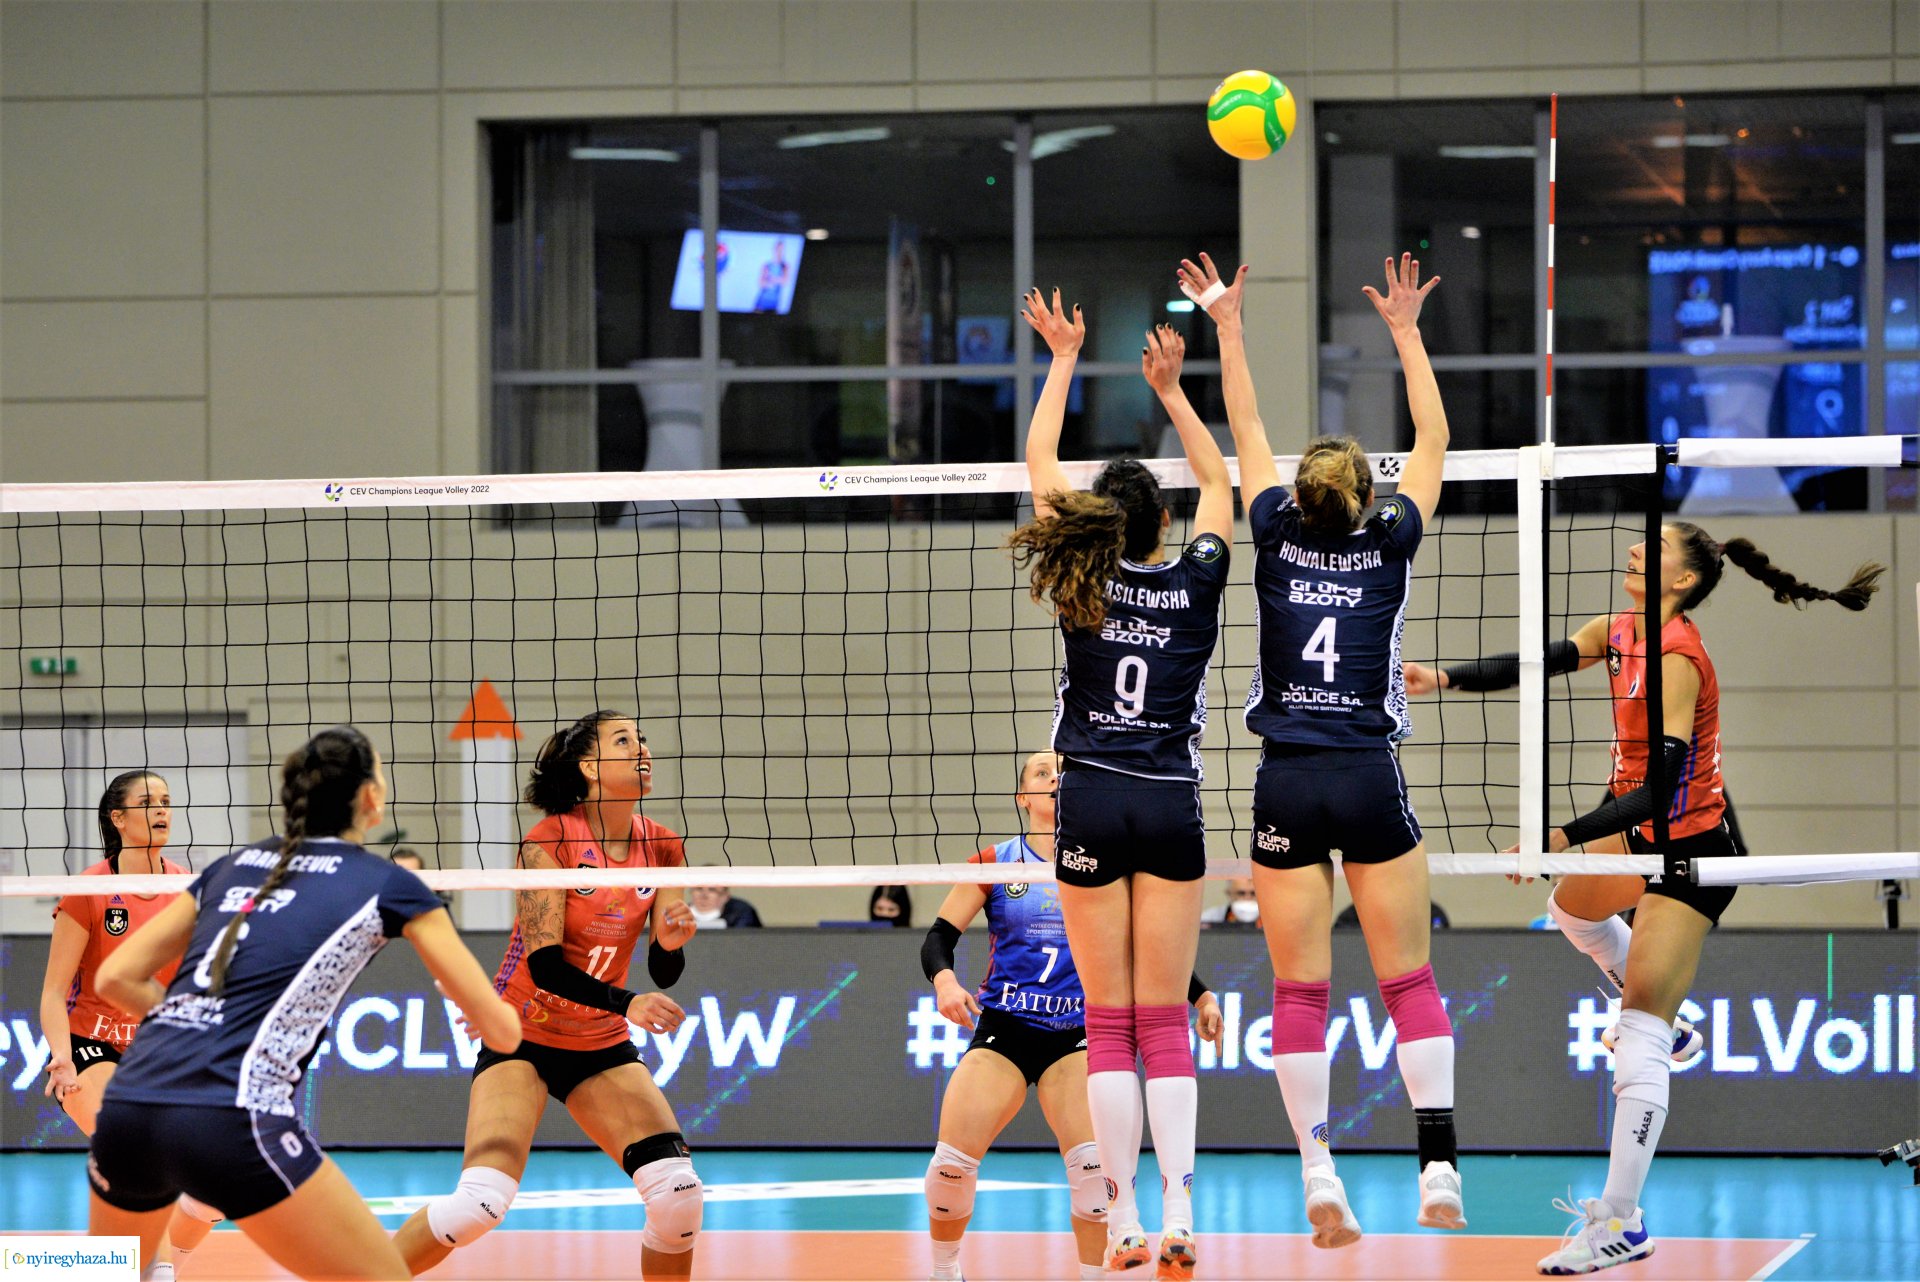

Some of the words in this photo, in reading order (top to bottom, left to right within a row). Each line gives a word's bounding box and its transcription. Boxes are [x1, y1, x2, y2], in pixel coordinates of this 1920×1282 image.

[350, 487, 367, 495] CEV
[368, 486, 412, 497] Champions
[414, 487, 443, 496] League
[445, 486, 469, 495] Volley
[471, 485, 490, 493] 2022
[845, 476, 861, 484] CEV
[863, 475, 904, 485] Champions
[910, 475, 940, 484] League
[941, 474, 966, 483] Volley
[967, 473, 987, 481] 2022
[1101, 580, 1190, 609] ASILEWSKA
[1302, 616, 1341, 683] 4
[1114, 655, 1149, 719] 9
[1281, 692, 1340, 704] POLICE
[585, 945, 618, 980] 17
[1042, 947, 1058, 983] 7
[998, 982, 1082, 1013] FATUM
